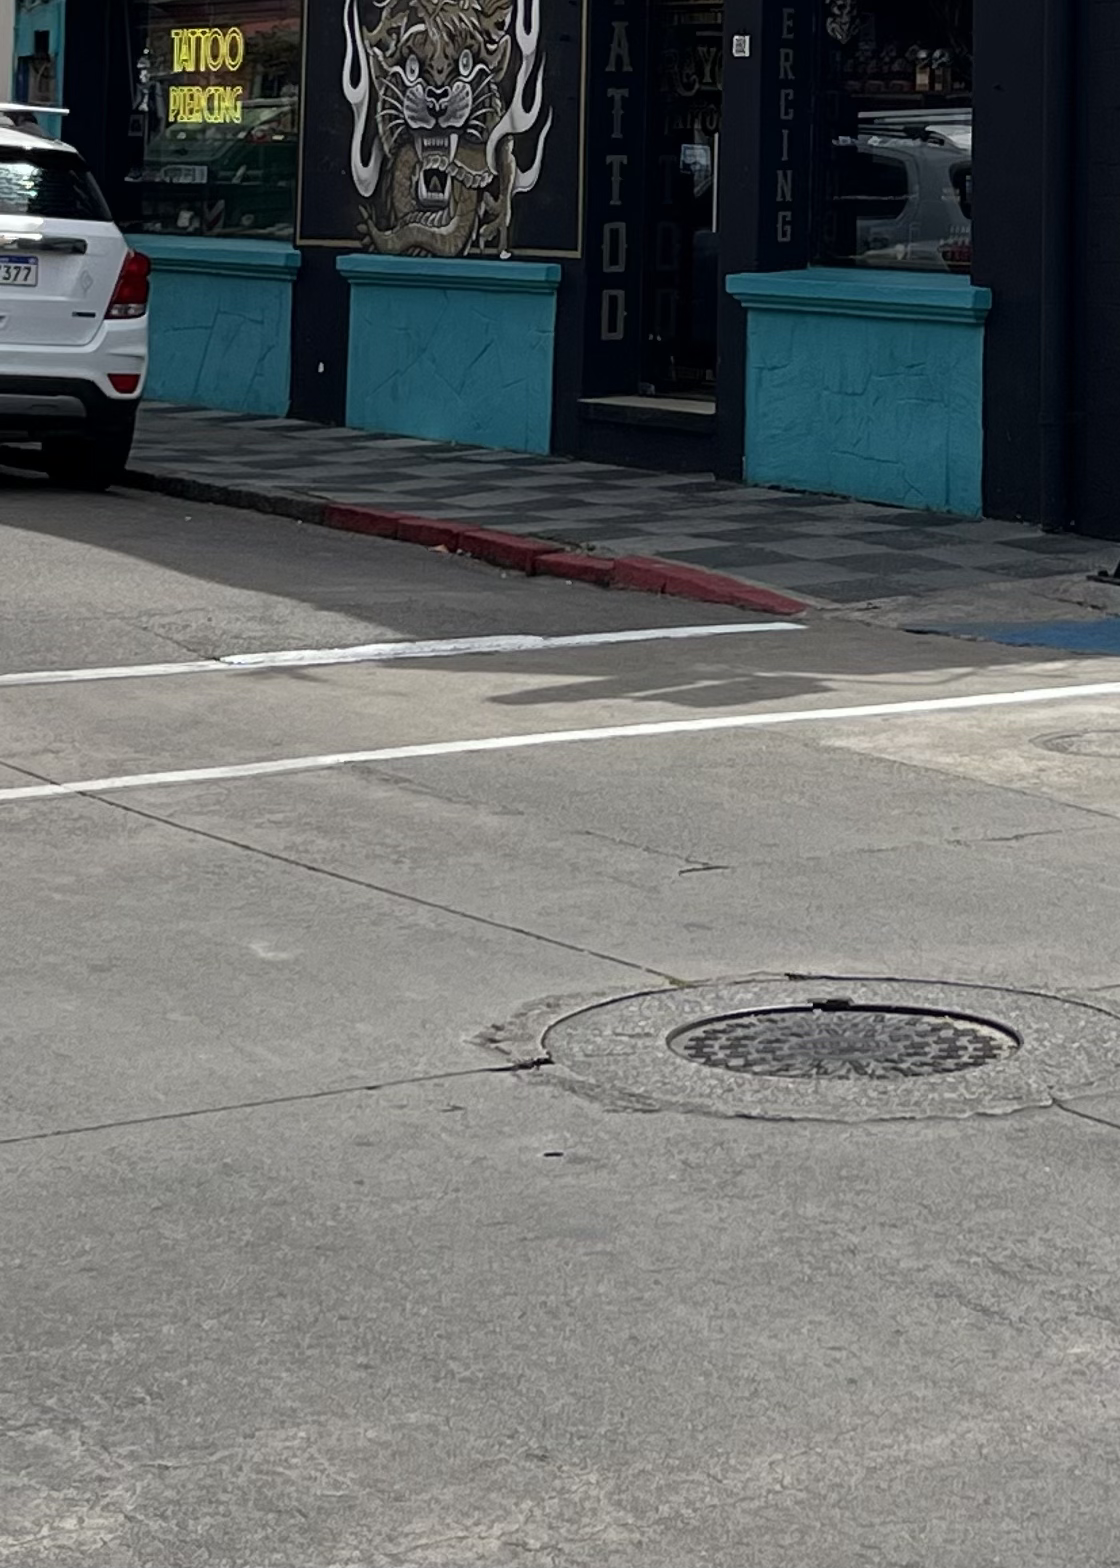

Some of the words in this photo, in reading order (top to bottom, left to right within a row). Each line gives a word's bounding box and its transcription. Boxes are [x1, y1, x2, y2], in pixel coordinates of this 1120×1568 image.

[171, 27, 244, 72] TATTOO
[168, 86, 243, 123] PIERCING
[0, 265, 32, 282] 377
